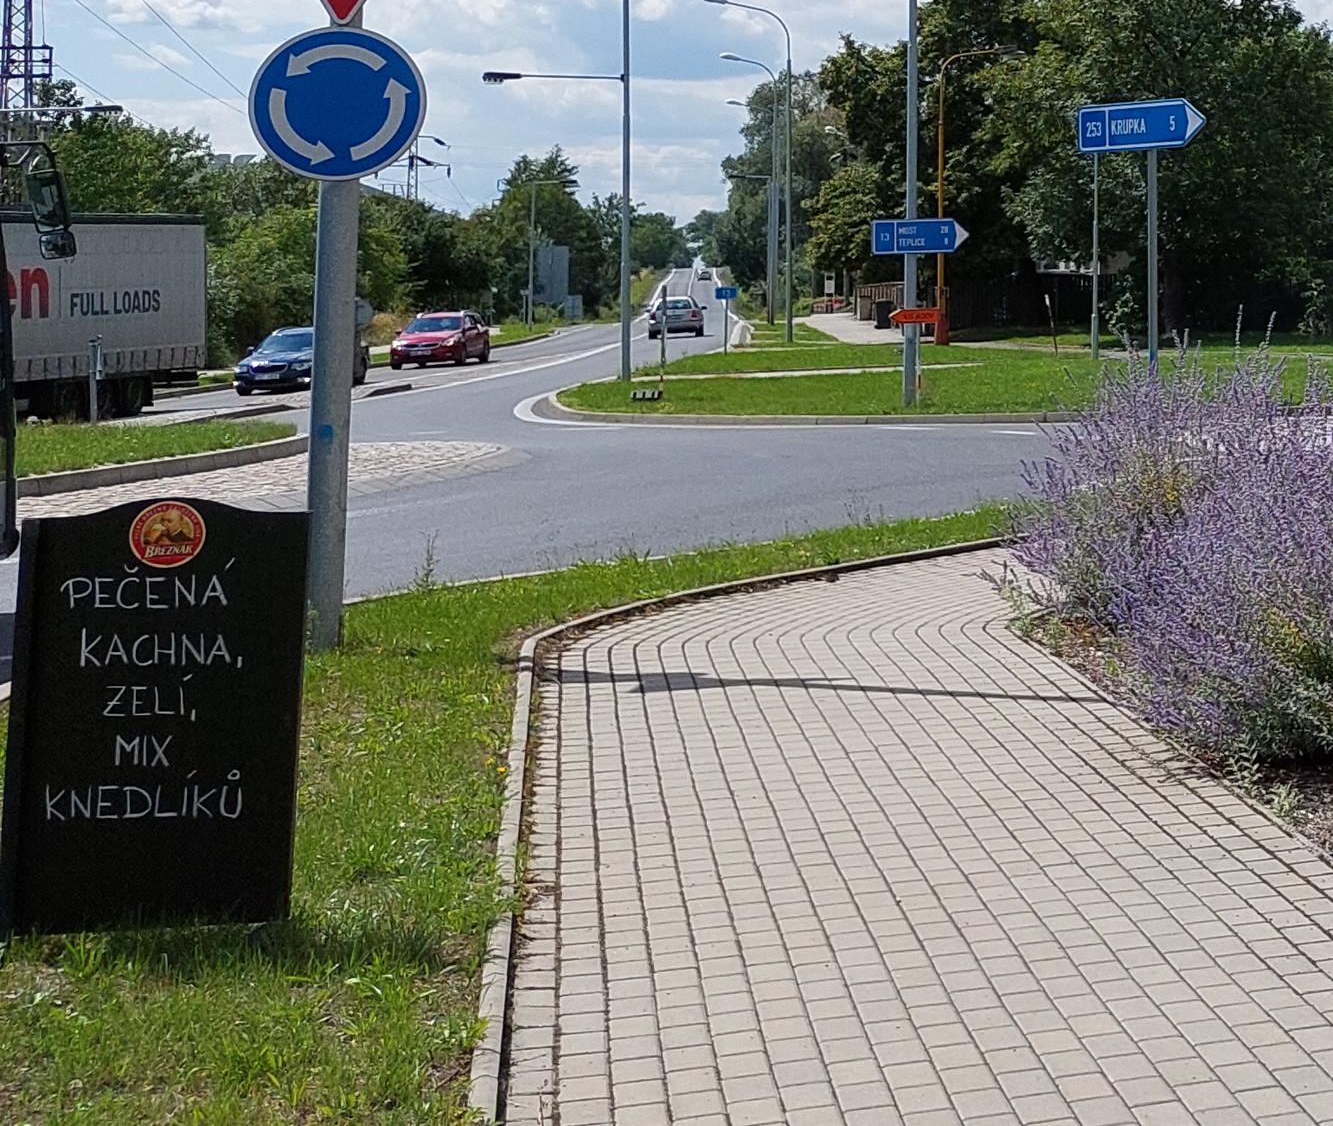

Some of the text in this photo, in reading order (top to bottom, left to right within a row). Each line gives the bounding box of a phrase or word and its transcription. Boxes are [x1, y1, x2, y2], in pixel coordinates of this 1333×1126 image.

[1086, 115, 1176, 137] 253 KRUPKA 5
[70, 292, 110, 317] FULL
[113, 289, 161, 315] LOADS
[60, 557, 236, 610] PEČENÁ
[79, 627, 244, 670] KACHNA,
[103, 673, 197, 722] ZELÍ,
[114, 734, 173, 768] MIX
[45, 769, 243, 820] KNEDLÍKŮ
